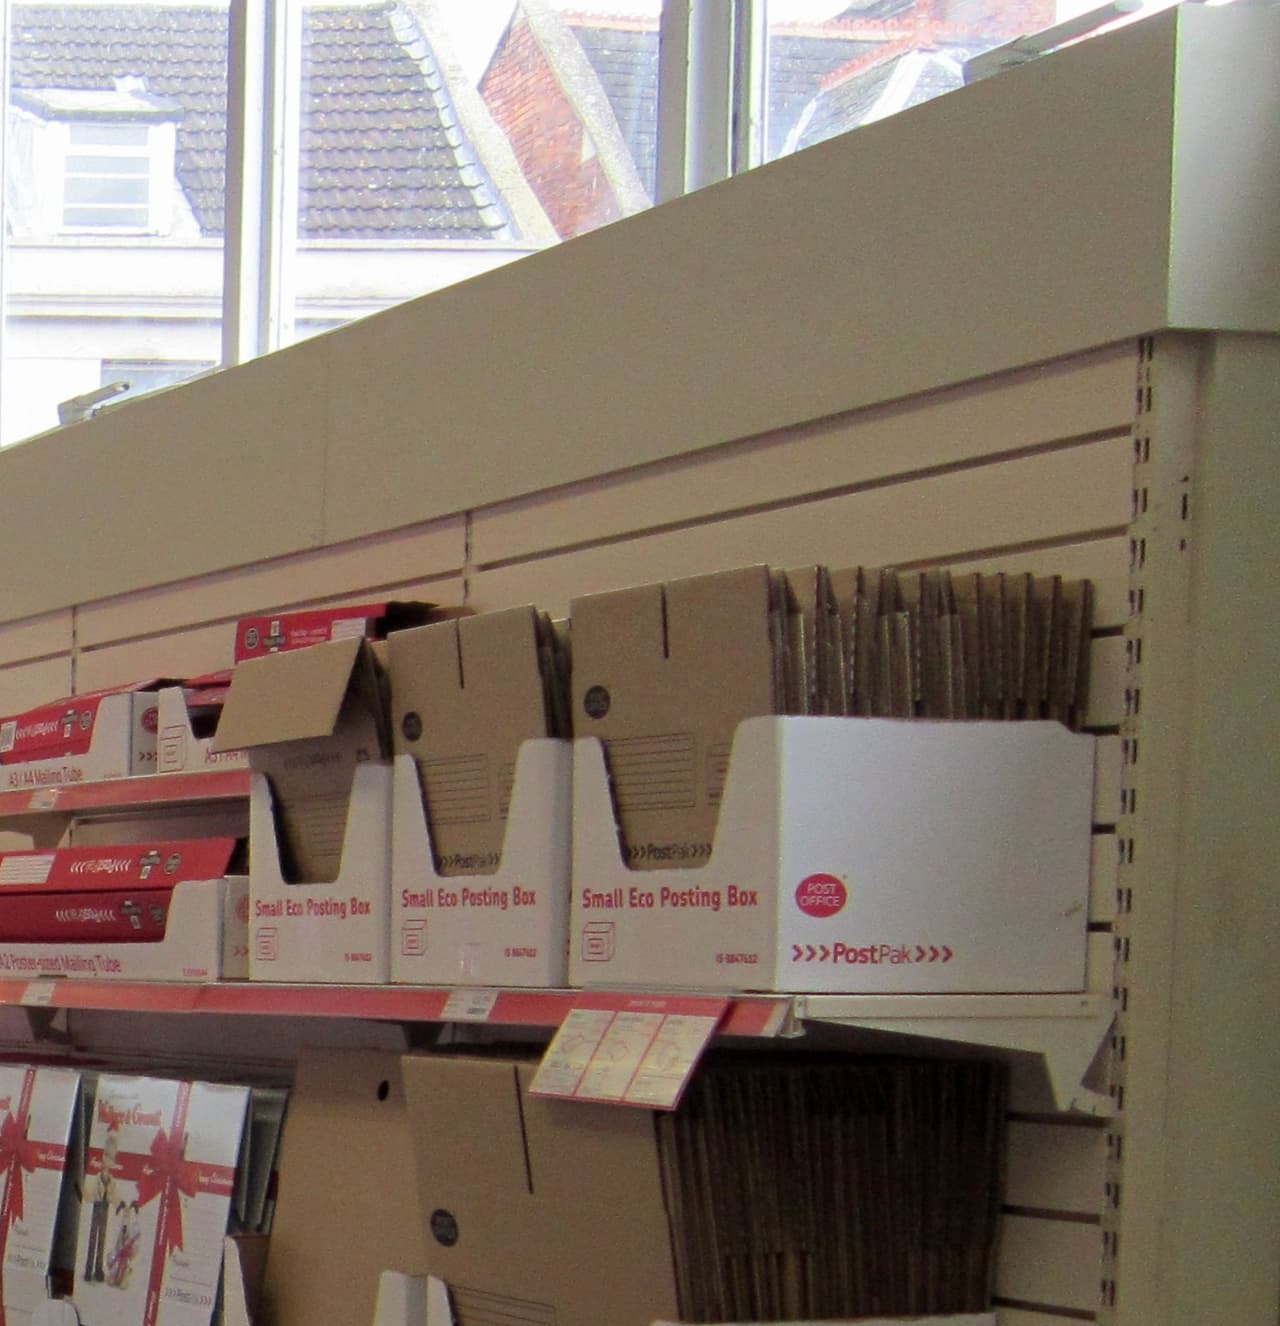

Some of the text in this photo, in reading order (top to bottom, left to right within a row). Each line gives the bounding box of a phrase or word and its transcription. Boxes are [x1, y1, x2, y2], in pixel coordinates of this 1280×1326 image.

[647, 843, 691, 861] PostPak
[401, 886, 537, 911] Small Eco Posting Box
[582, 885, 759, 911] Small Eco Posting Box
[807, 882, 836, 895] POST
[255, 898, 372, 920] Small Eco Posting Box
[800, 895, 841, 907] OFFICE
[832, 942, 912, 965] PostPak
